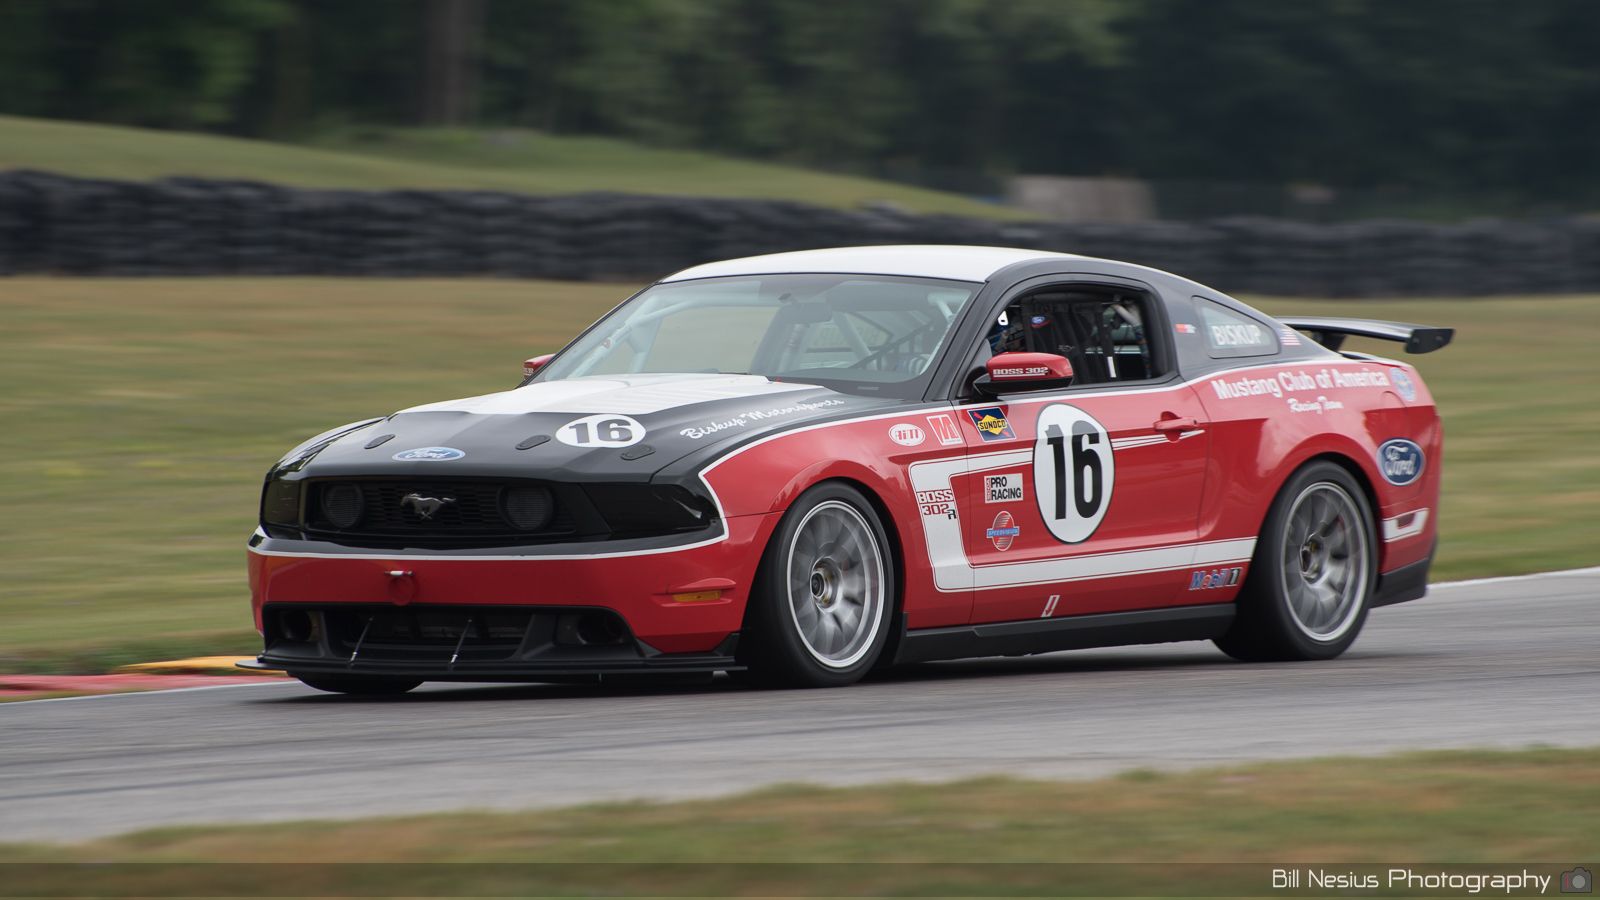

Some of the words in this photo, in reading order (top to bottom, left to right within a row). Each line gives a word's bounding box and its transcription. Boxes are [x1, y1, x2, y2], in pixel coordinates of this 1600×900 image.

[1210, 324, 1262, 346] BISKUP
[1210, 376, 1284, 399] Mustang
[1277, 370, 1316, 391] Club
[1314, 369, 1333, 389] of
[1331, 367, 1391, 388] America
[568, 418, 633, 444] 16
[679, 417, 747, 440] Biskup
[978, 419, 1007, 430] SUNOCO
[404, 449, 452, 459] Ford
[1044, 419, 1103, 520] 16
[990, 476, 1008, 488] PRO
[917, 489, 954, 503] BOSS
[991, 487, 1022, 501] RACING
[987, 527, 1018, 537] SPEEDVISION
[1188, 568, 1229, 591] Mobil
[1227, 567, 1241, 587] 1
